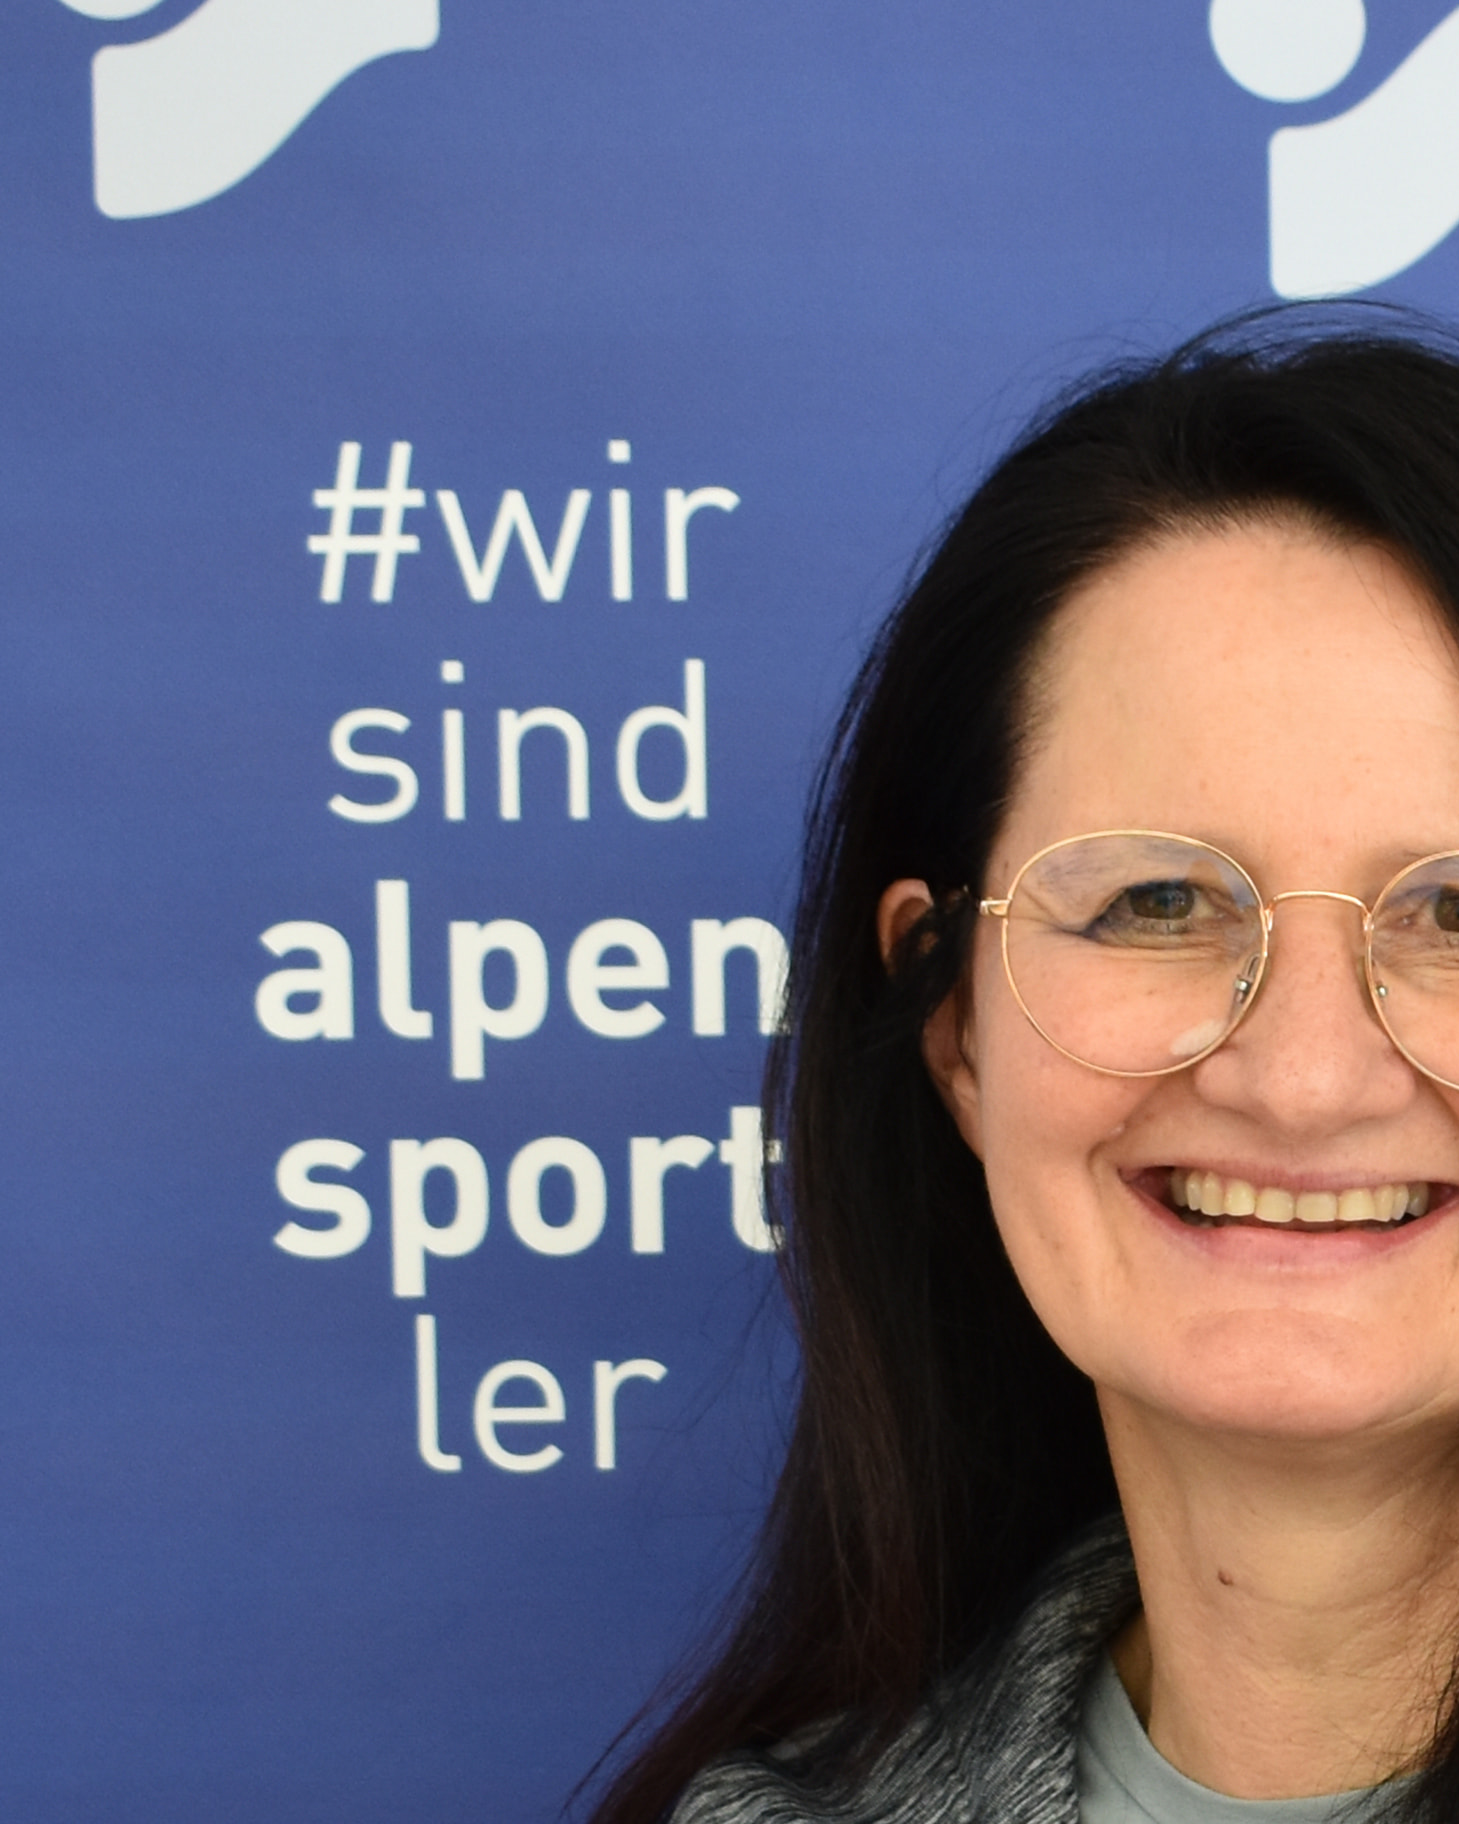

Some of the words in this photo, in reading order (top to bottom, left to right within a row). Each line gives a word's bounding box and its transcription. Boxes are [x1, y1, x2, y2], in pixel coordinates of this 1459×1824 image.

[307, 439, 740, 603] #wir
[328, 658, 708, 823] sind
[254, 879, 792, 1080] alpen
[272, 1106, 786, 1298] sport
[415, 1314, 667, 1472] ler
